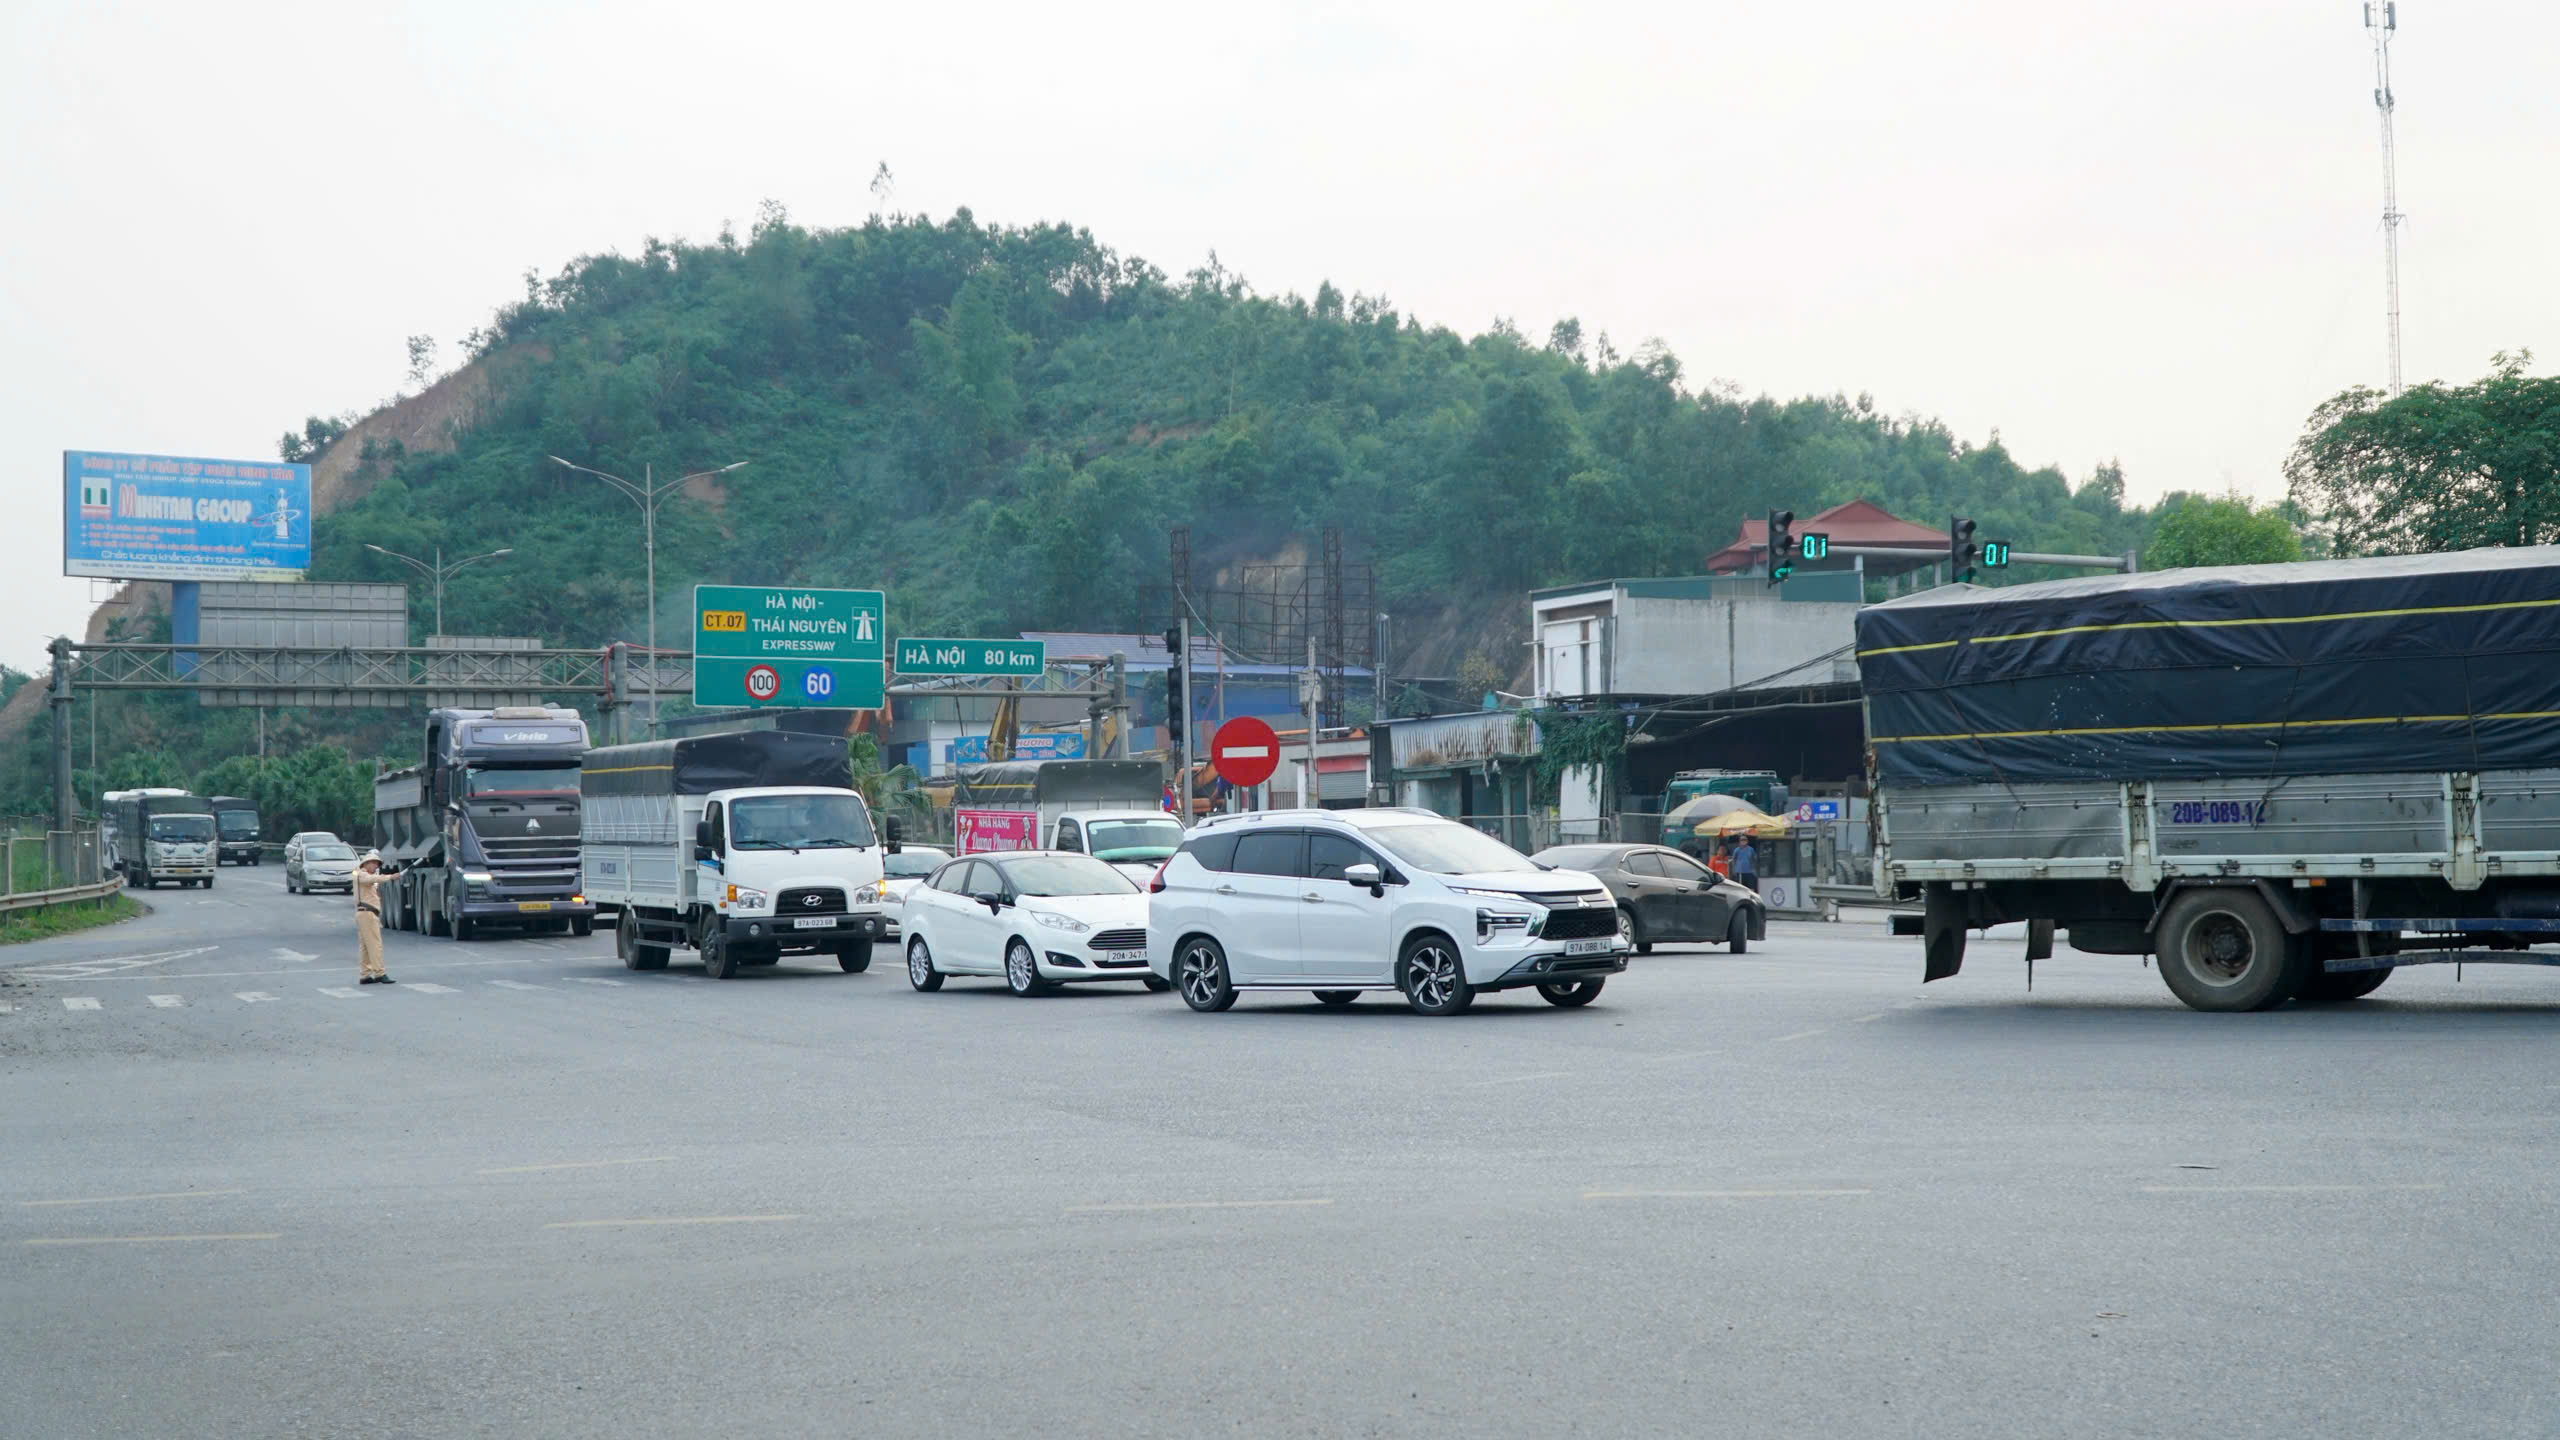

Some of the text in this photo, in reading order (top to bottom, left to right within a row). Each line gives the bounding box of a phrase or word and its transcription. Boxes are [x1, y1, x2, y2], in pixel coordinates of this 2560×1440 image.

[196, 498, 252, 524] GROUP
[1803, 536, 1827, 559] 01
[1985, 543, 2008, 566] 01
[765, 592, 787, 609] HÀ
[705, 614, 743, 628] CT.07
[752, 616, 847, 635] THÁI NGUYÊN
[762, 639, 836, 652] EXPRESSWAY
[905, 645, 1035, 669] HÀ NỘI 80 km
[751, 674, 774, 691] 100
[807, 673, 830, 695] 60
[978, 815, 992, 828] NHÀ
[2172, 801, 2266, 824] 20B-089.12
